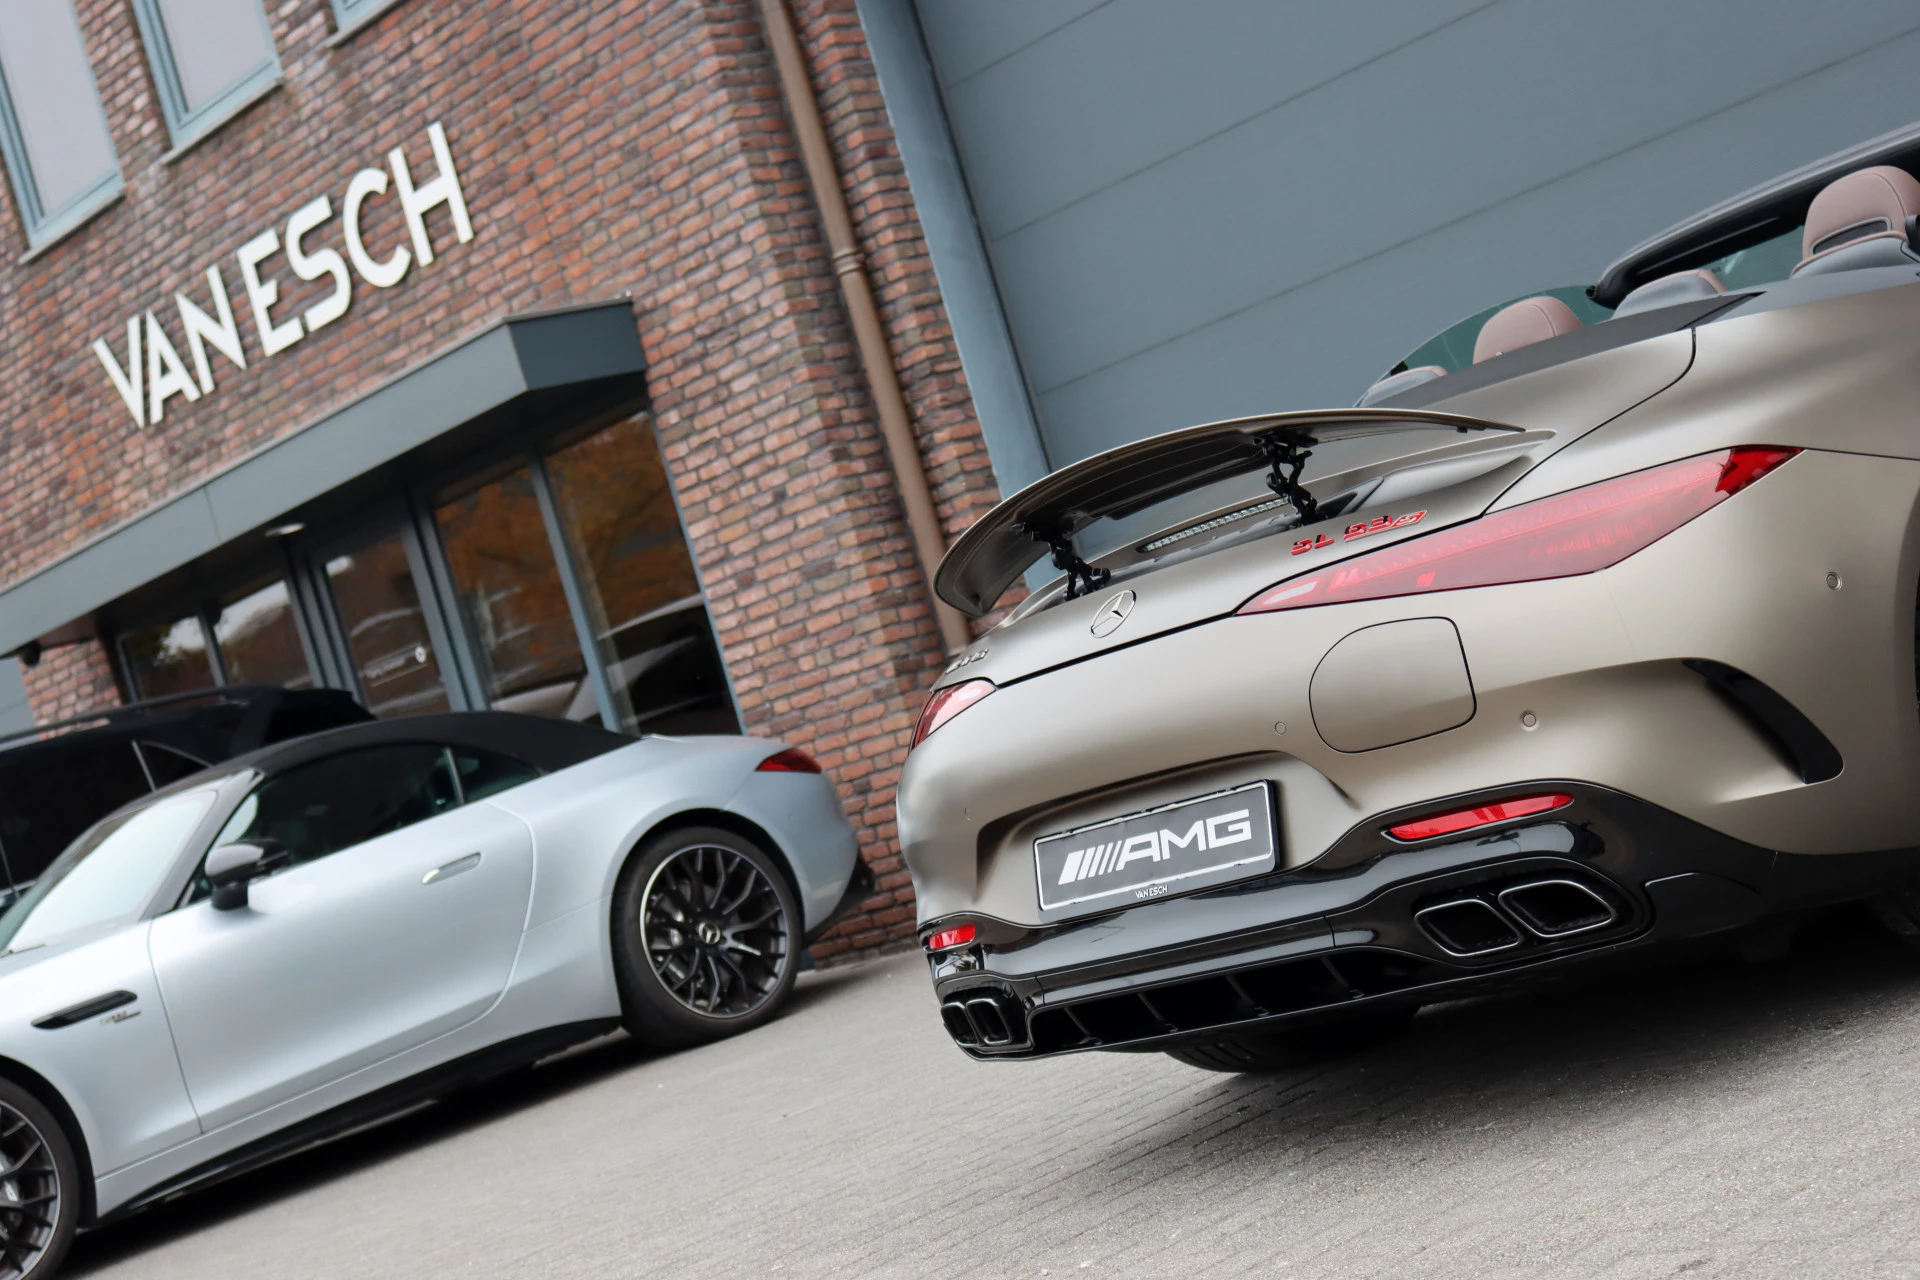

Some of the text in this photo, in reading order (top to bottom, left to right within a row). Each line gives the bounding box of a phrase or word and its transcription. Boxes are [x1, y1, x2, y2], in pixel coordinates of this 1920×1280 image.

[92, 120, 475, 429] VAN ESCH
[1115, 808, 1252, 872] AMG
